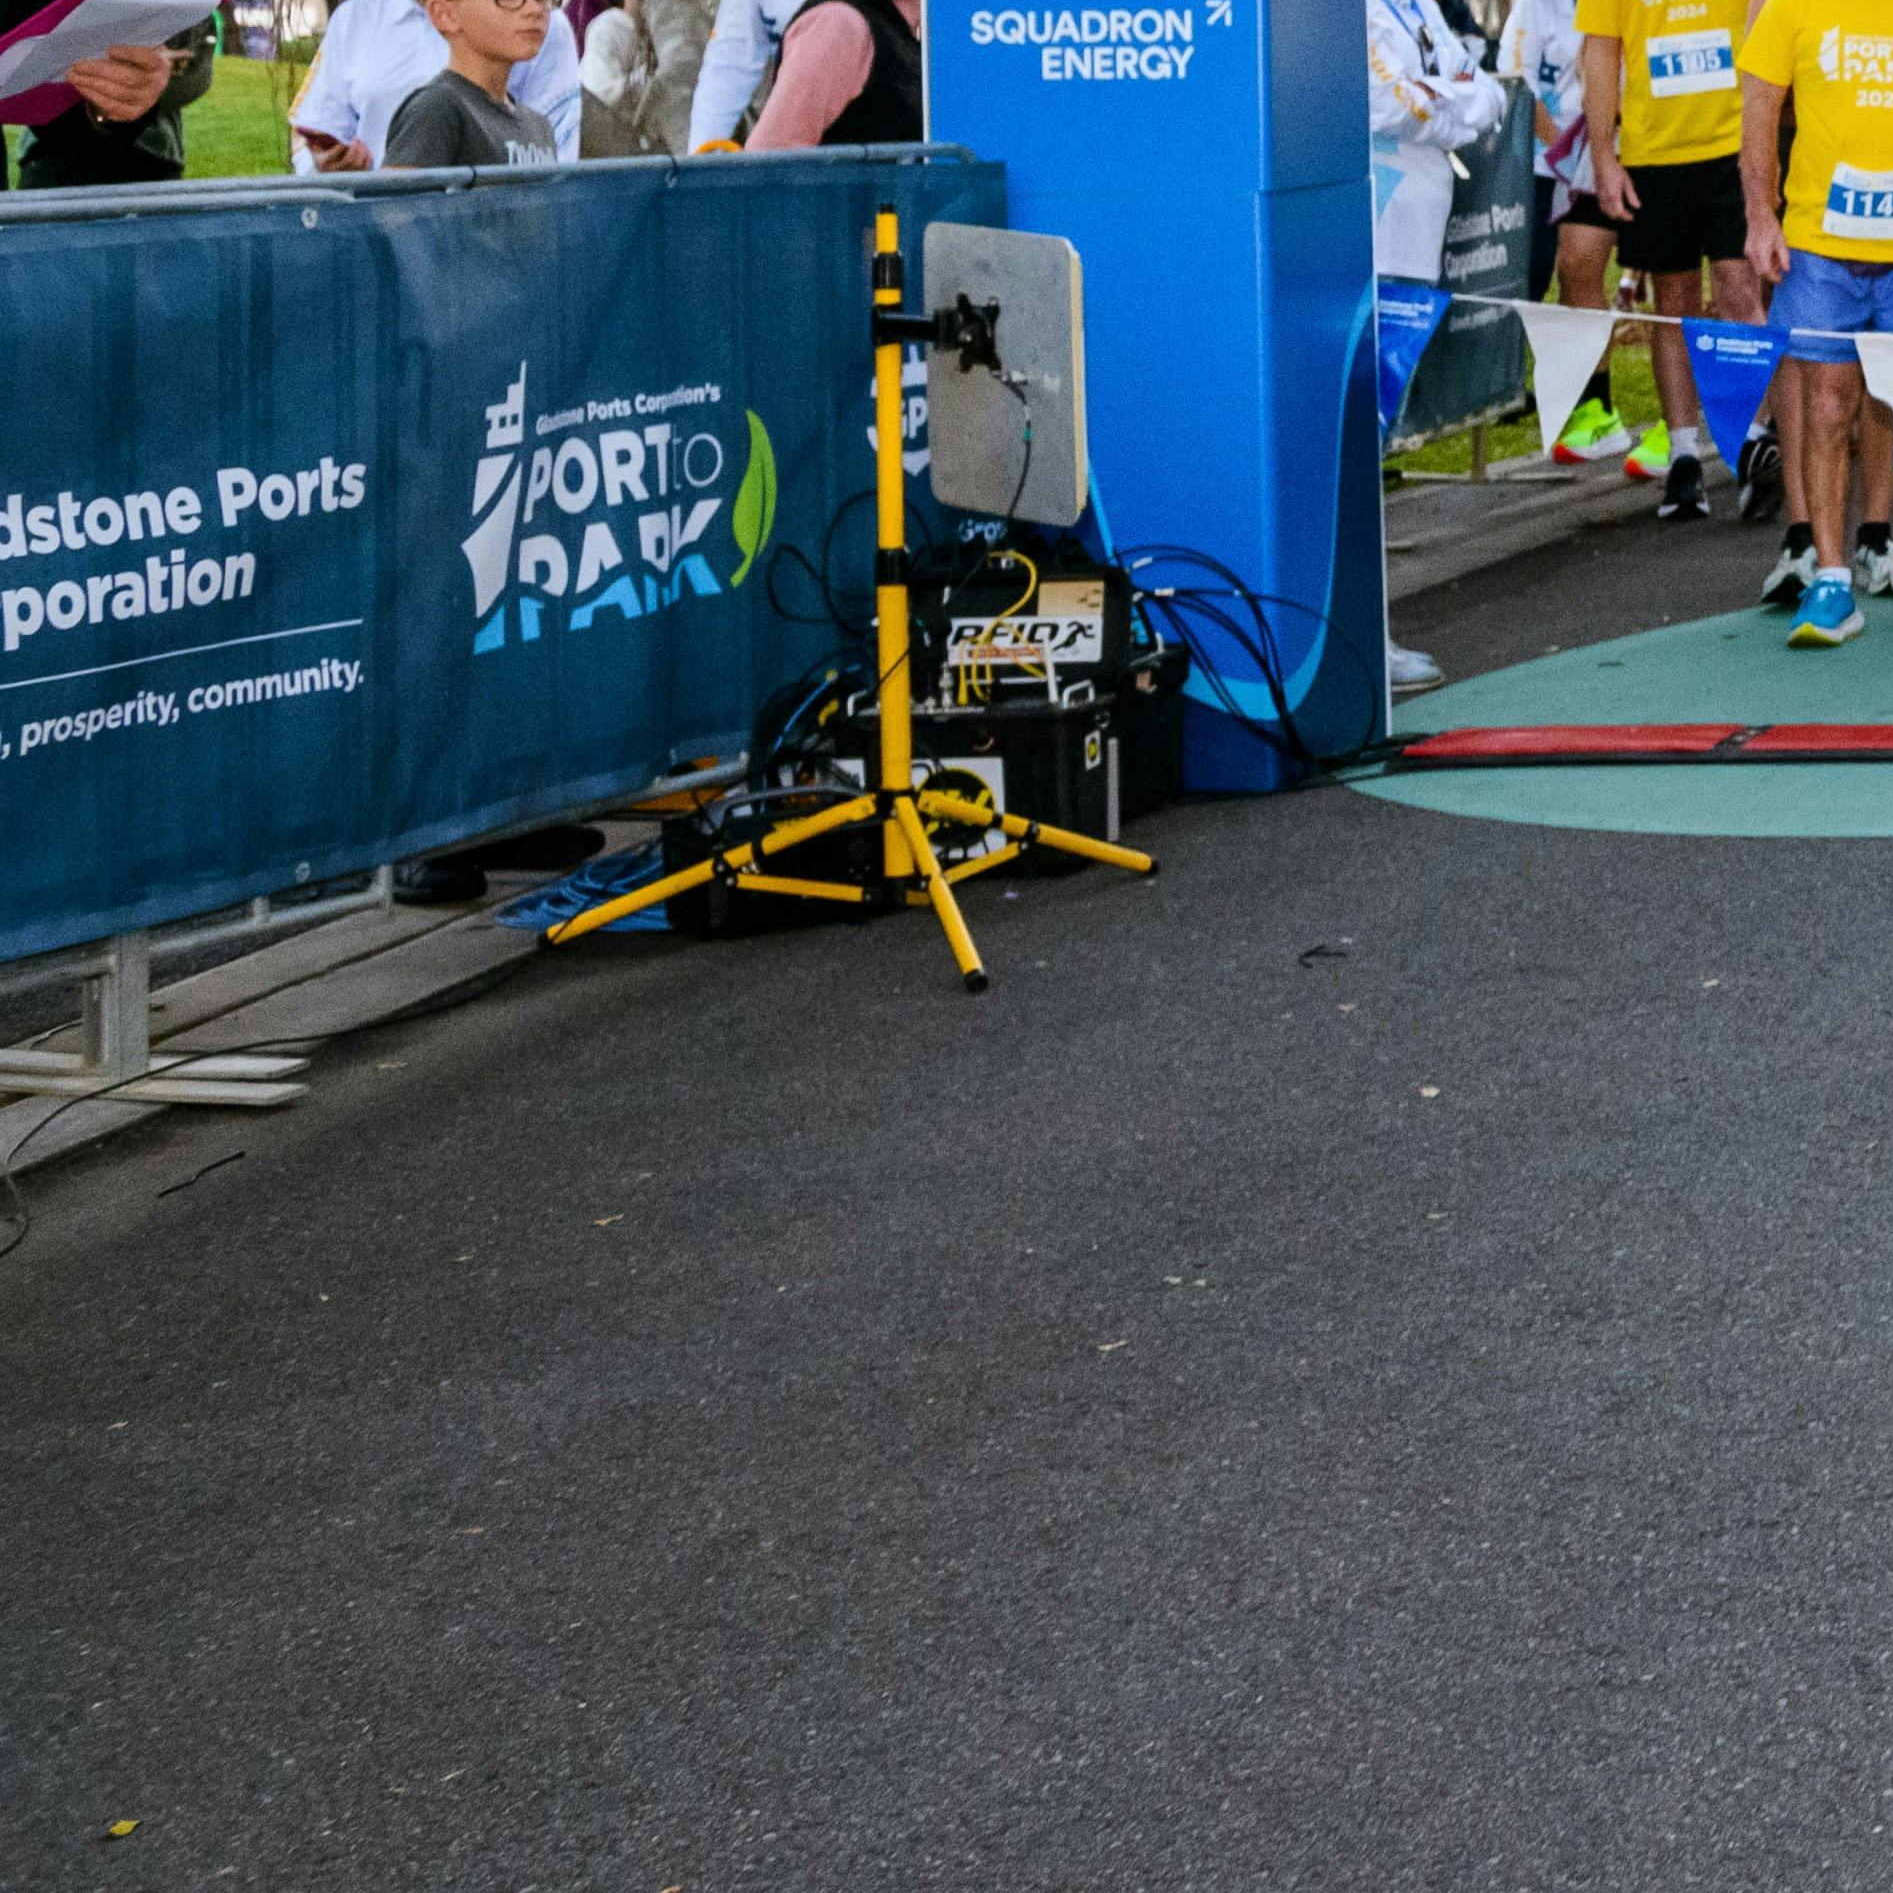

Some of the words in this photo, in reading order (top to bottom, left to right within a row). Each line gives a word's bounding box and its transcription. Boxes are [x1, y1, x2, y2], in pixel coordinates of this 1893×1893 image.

[970, 8, 1194, 45] SQUADRON
[1041, 44, 1196, 81] ENERGY
[1661, 47, 1722, 77] 1105
[586, 397, 633, 423] Ports
[525, 422, 672, 524] PORT
[0, 483, 202, 562] dstone
[215, 456, 368, 529] Ports
[0, 548, 257, 652] poration
[20, 687, 182, 757] prosperity,
[187, 655, 366, 716] community.
